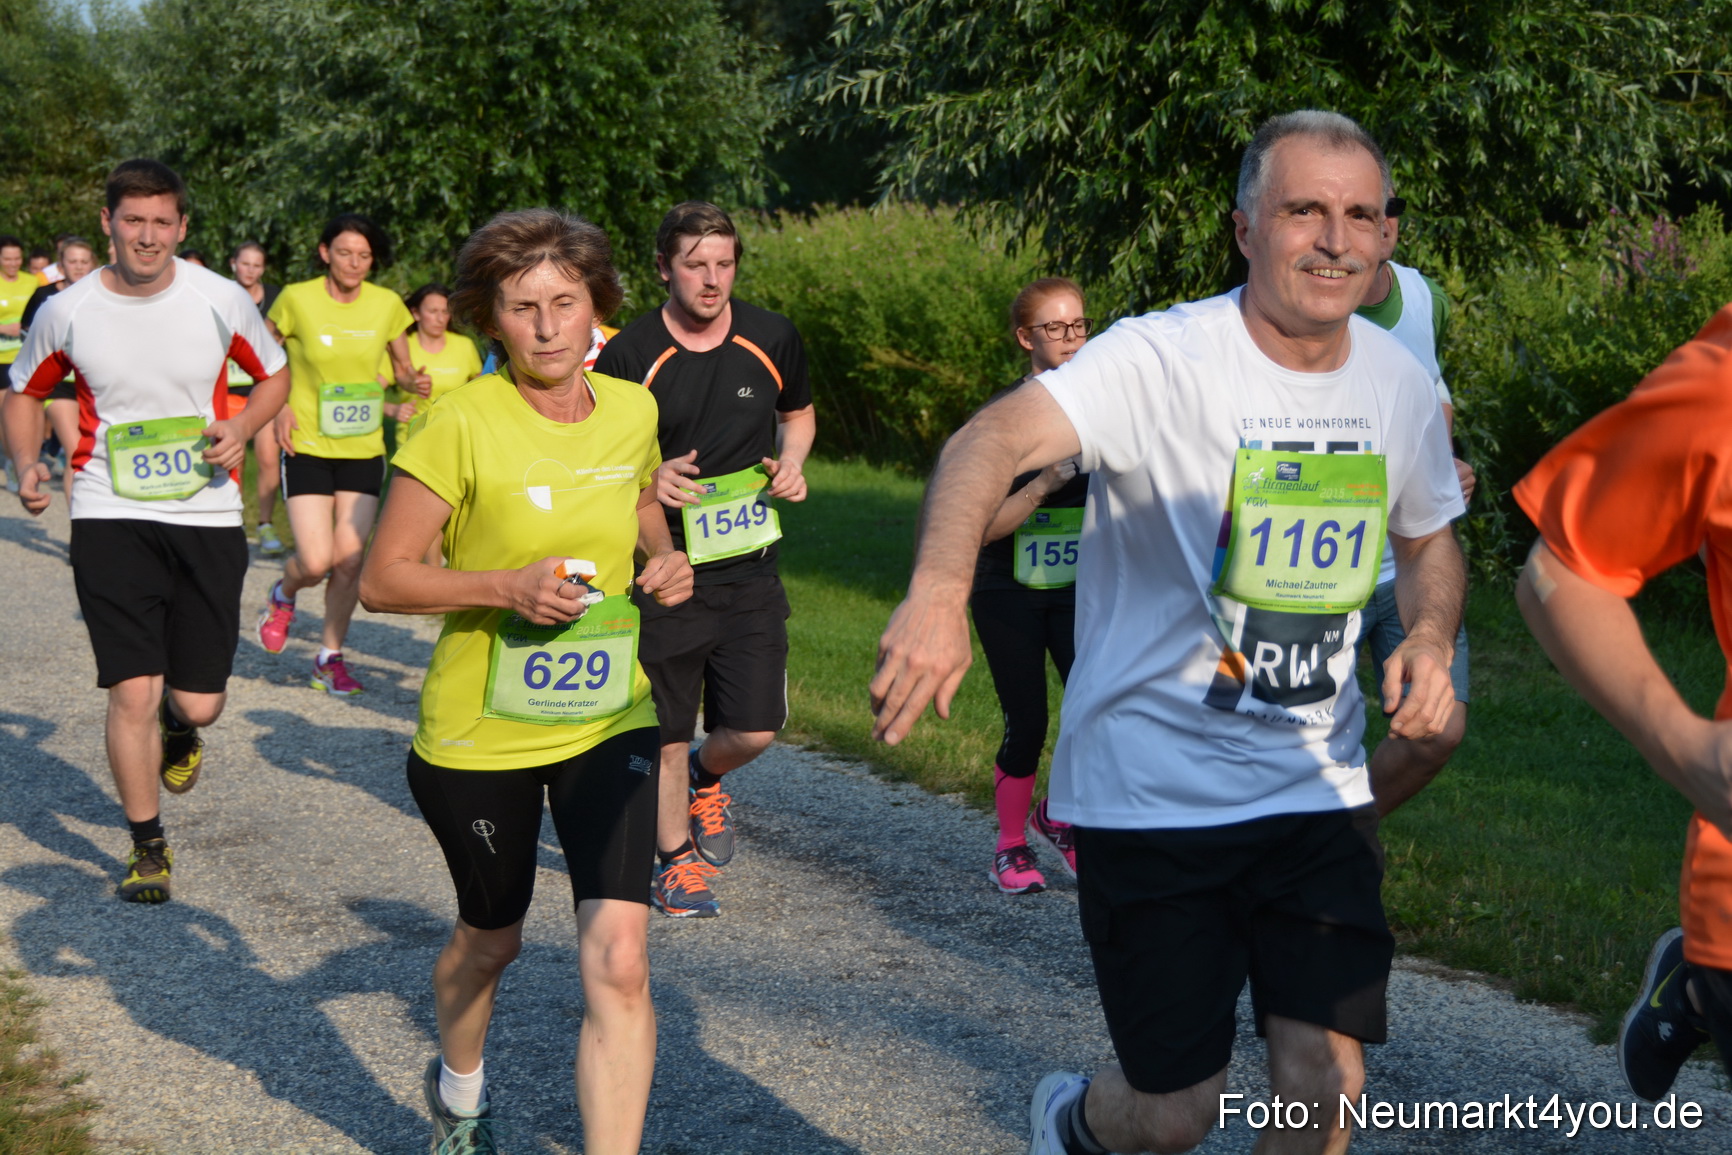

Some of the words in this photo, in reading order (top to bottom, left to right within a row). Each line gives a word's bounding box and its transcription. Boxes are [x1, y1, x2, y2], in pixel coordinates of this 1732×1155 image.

[333, 405, 371, 423] 628
[1259, 417, 1292, 428] NEUE
[1296, 418, 1372, 429] WOHNFORMEL
[132, 448, 192, 480] 830
[1262, 477, 1320, 492] firmenlauf
[1319, 487, 1346, 499] 2015
[695, 500, 768, 539] 1549
[1250, 517, 1367, 569] 1161
[1266, 579, 1303, 589] Michael
[1303, 580, 1338, 590] Zautner
[576, 624, 602, 635] 2015
[1322, 630, 1340, 643] NM
[523, 649, 611, 691] 629
[1252, 640, 1319, 689] RW
[528, 698, 567, 708] Gerlinde
[567, 700, 599, 708] Kratzer
[440, 738, 475, 748] SPIRO
